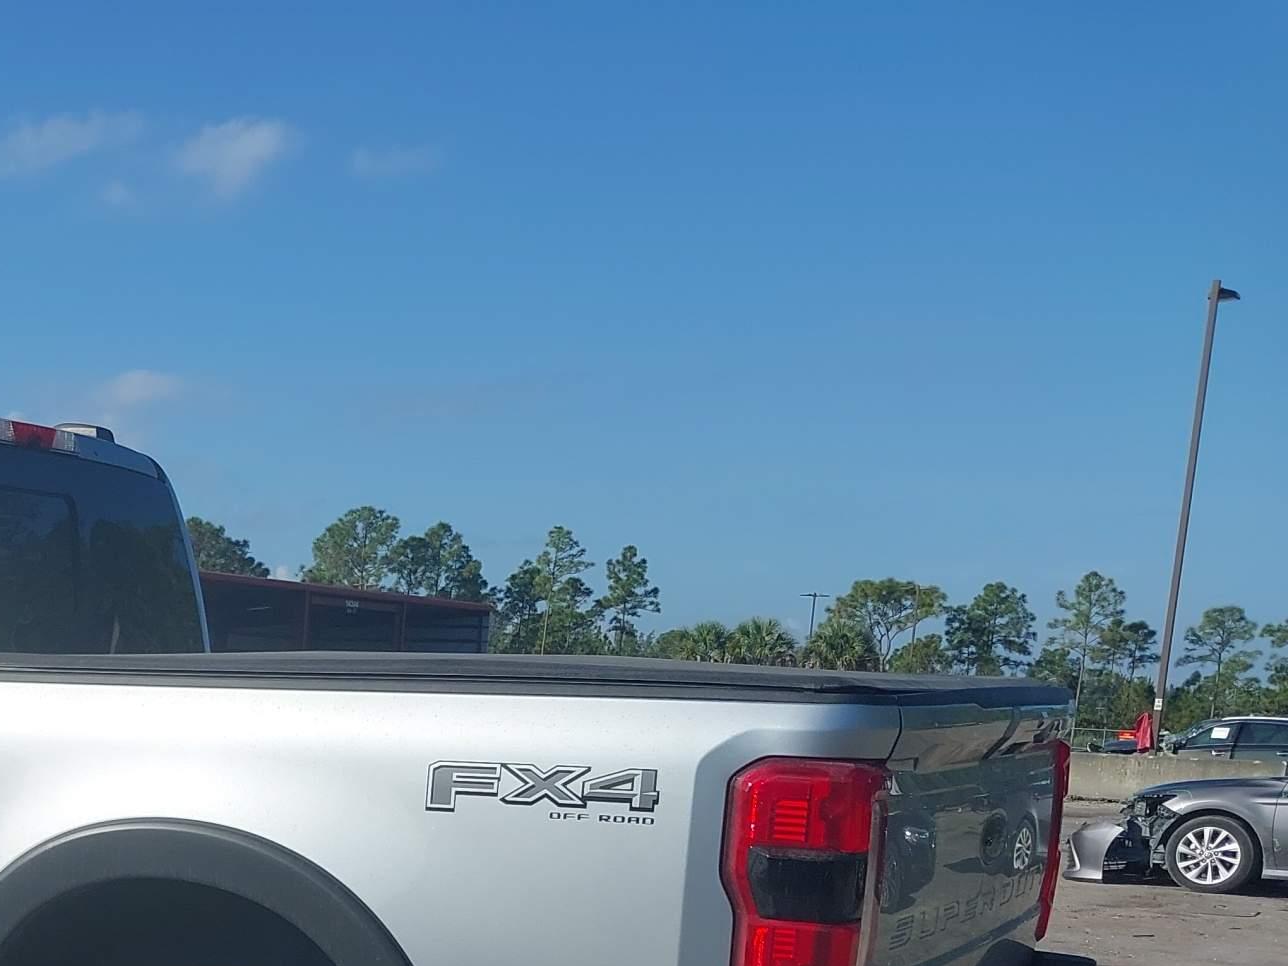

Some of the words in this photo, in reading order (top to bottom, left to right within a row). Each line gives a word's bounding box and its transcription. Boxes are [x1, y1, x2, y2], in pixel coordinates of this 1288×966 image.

[425, 760, 660, 812] FX4
[549, 812, 591, 821] OFF
[598, 814, 655, 826] ROAD
[888, 884, 998, 950] SUPER
